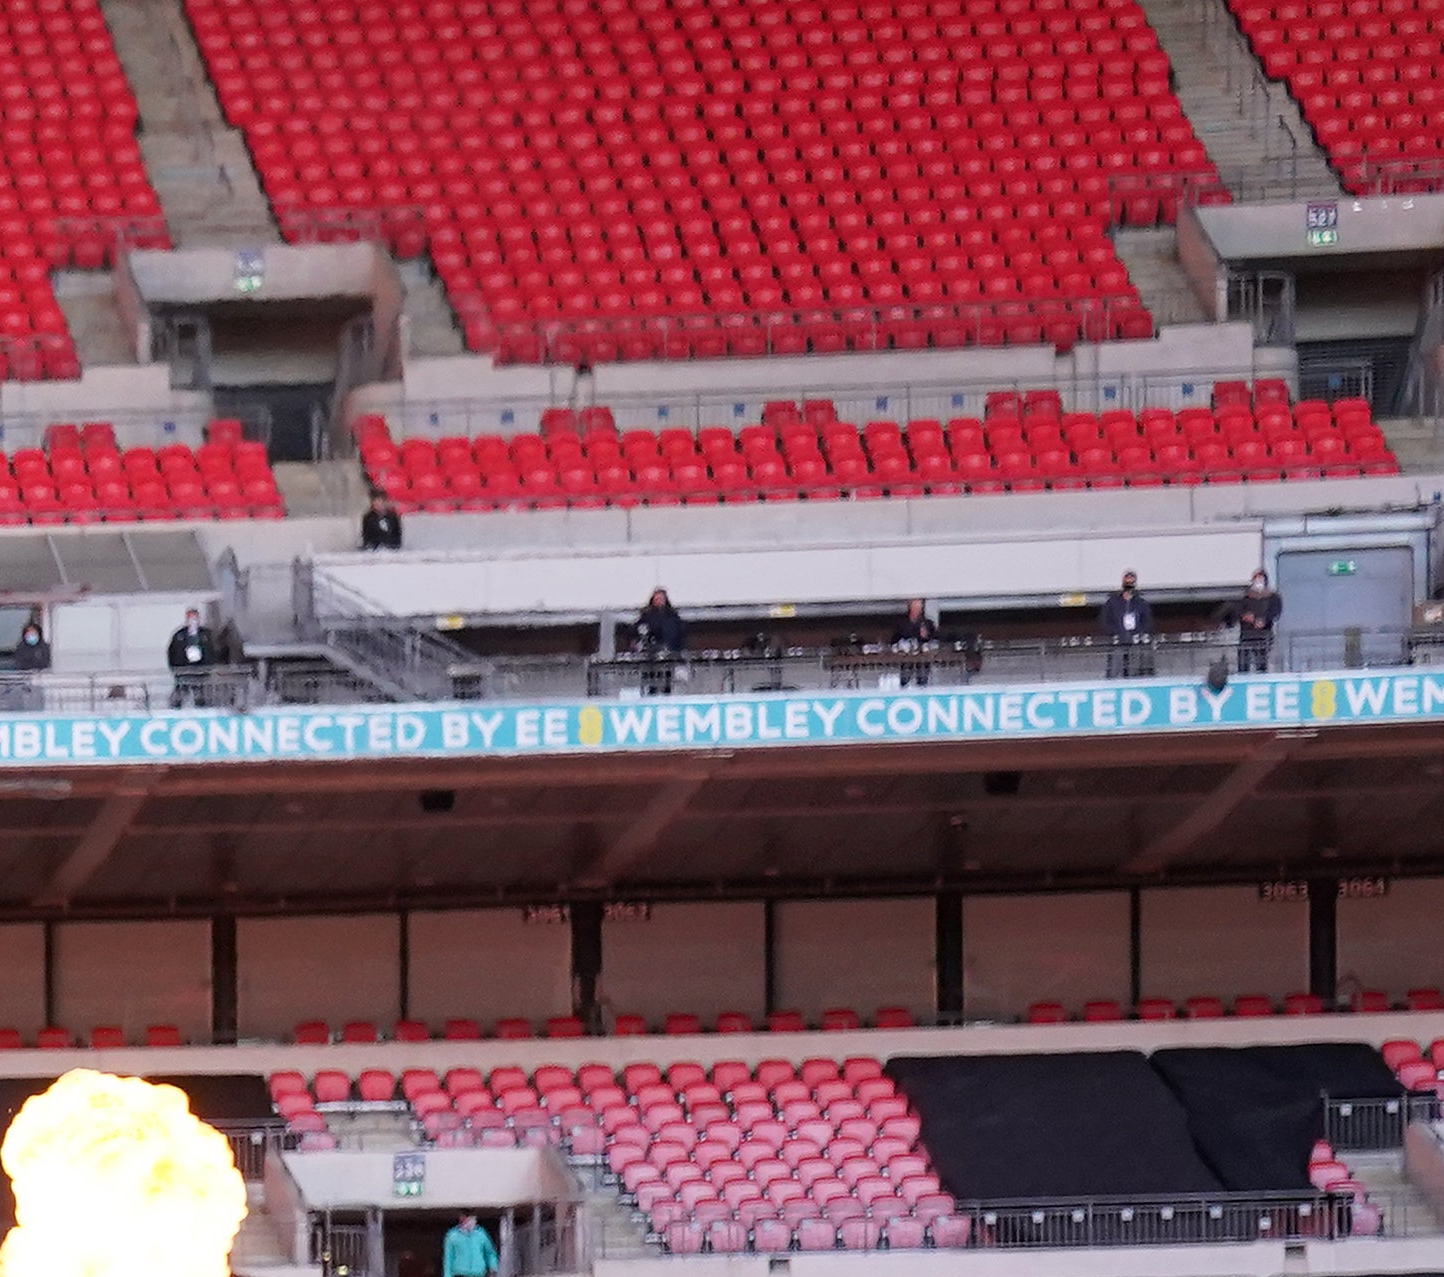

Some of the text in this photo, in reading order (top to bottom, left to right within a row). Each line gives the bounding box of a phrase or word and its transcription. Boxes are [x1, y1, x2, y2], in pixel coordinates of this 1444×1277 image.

[140, 710, 431, 757] CONNECTED
[443, 708, 504, 749] BY
[516, 707, 569, 747] EE
[608, 684, 1299, 747] WEMBLEY CONNECTED BY EE
